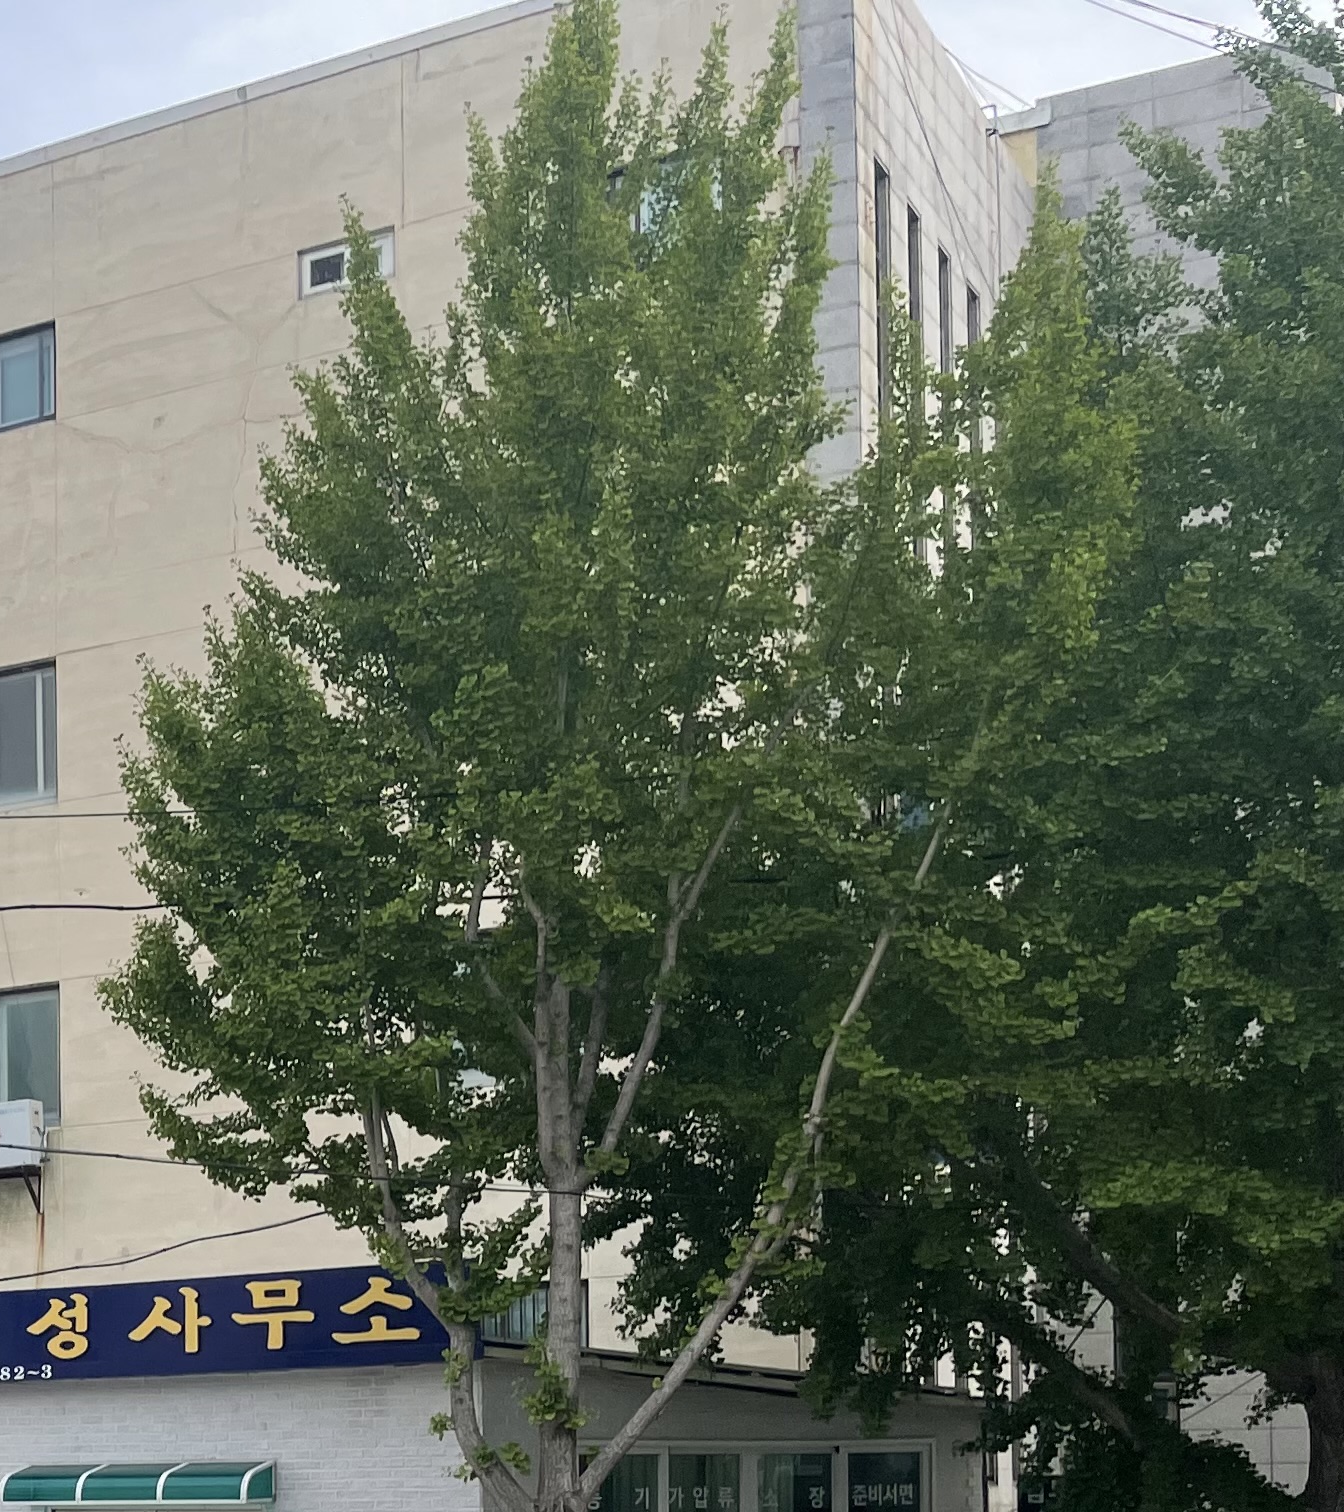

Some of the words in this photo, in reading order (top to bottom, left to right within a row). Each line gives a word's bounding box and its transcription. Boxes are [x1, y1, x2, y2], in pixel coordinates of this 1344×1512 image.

[128, 1276, 421, 1354] 사무소
[669, 1486, 734, 1509] 가압류
[852, 1483, 913, 1506] 준비서면
